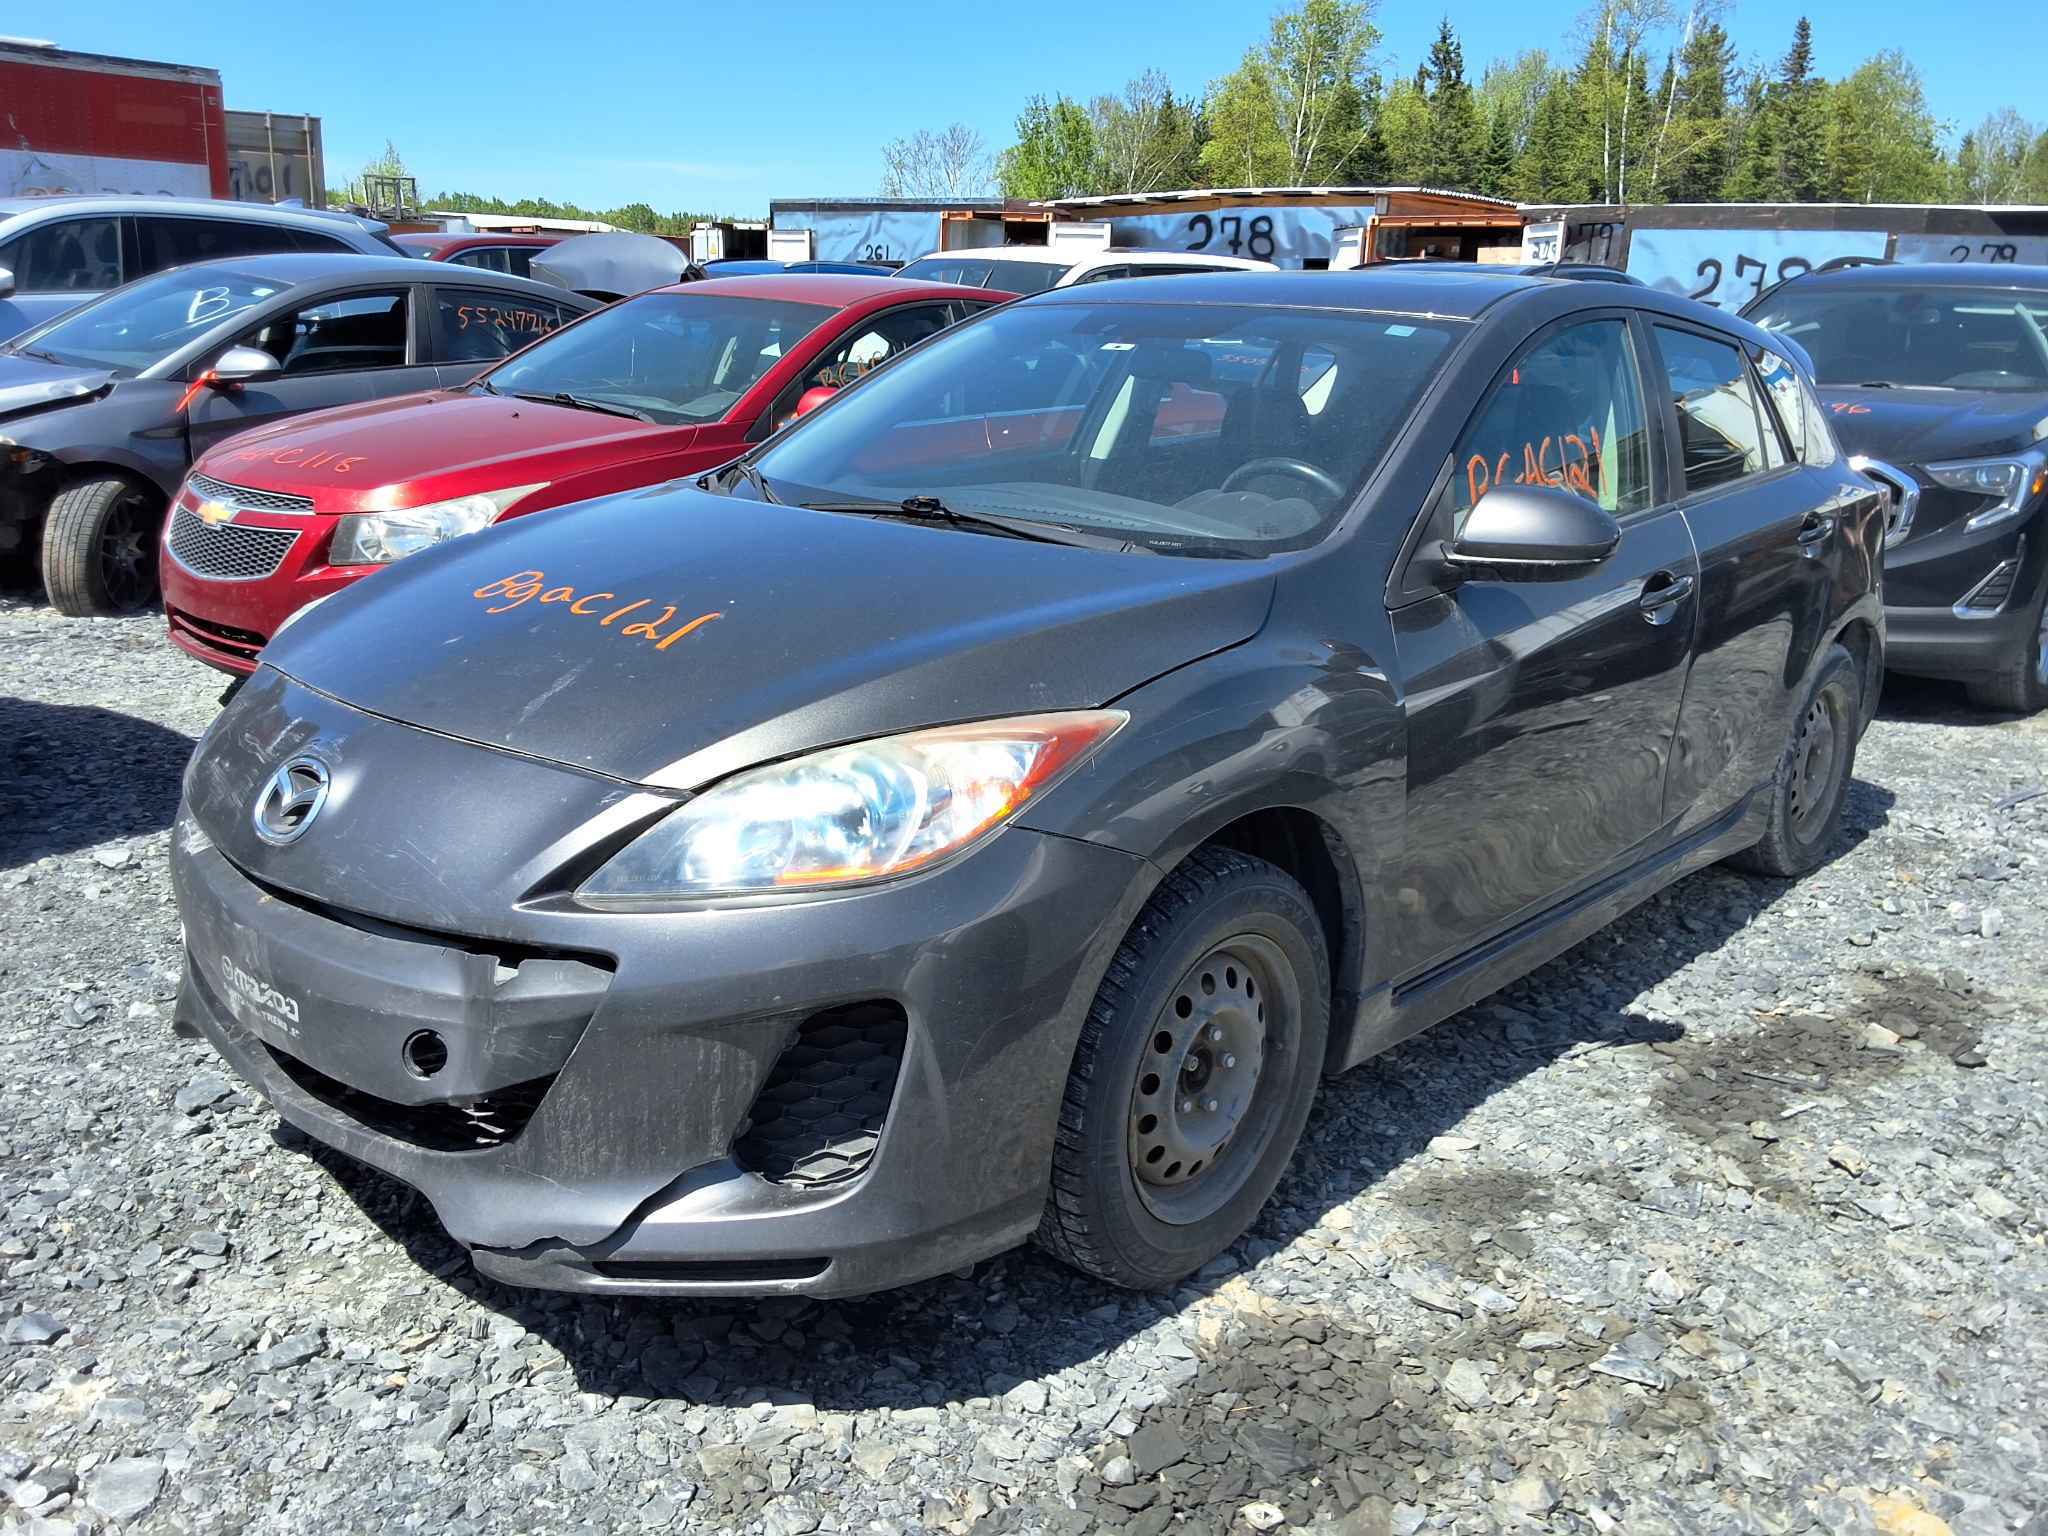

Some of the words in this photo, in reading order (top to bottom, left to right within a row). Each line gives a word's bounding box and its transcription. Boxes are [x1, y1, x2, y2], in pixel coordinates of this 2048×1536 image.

[865, 244, 889, 261] 261
[1186, 214, 1275, 262] 278
[1949, 243, 2018, 264] 279
[186, 286, 231, 323] B
